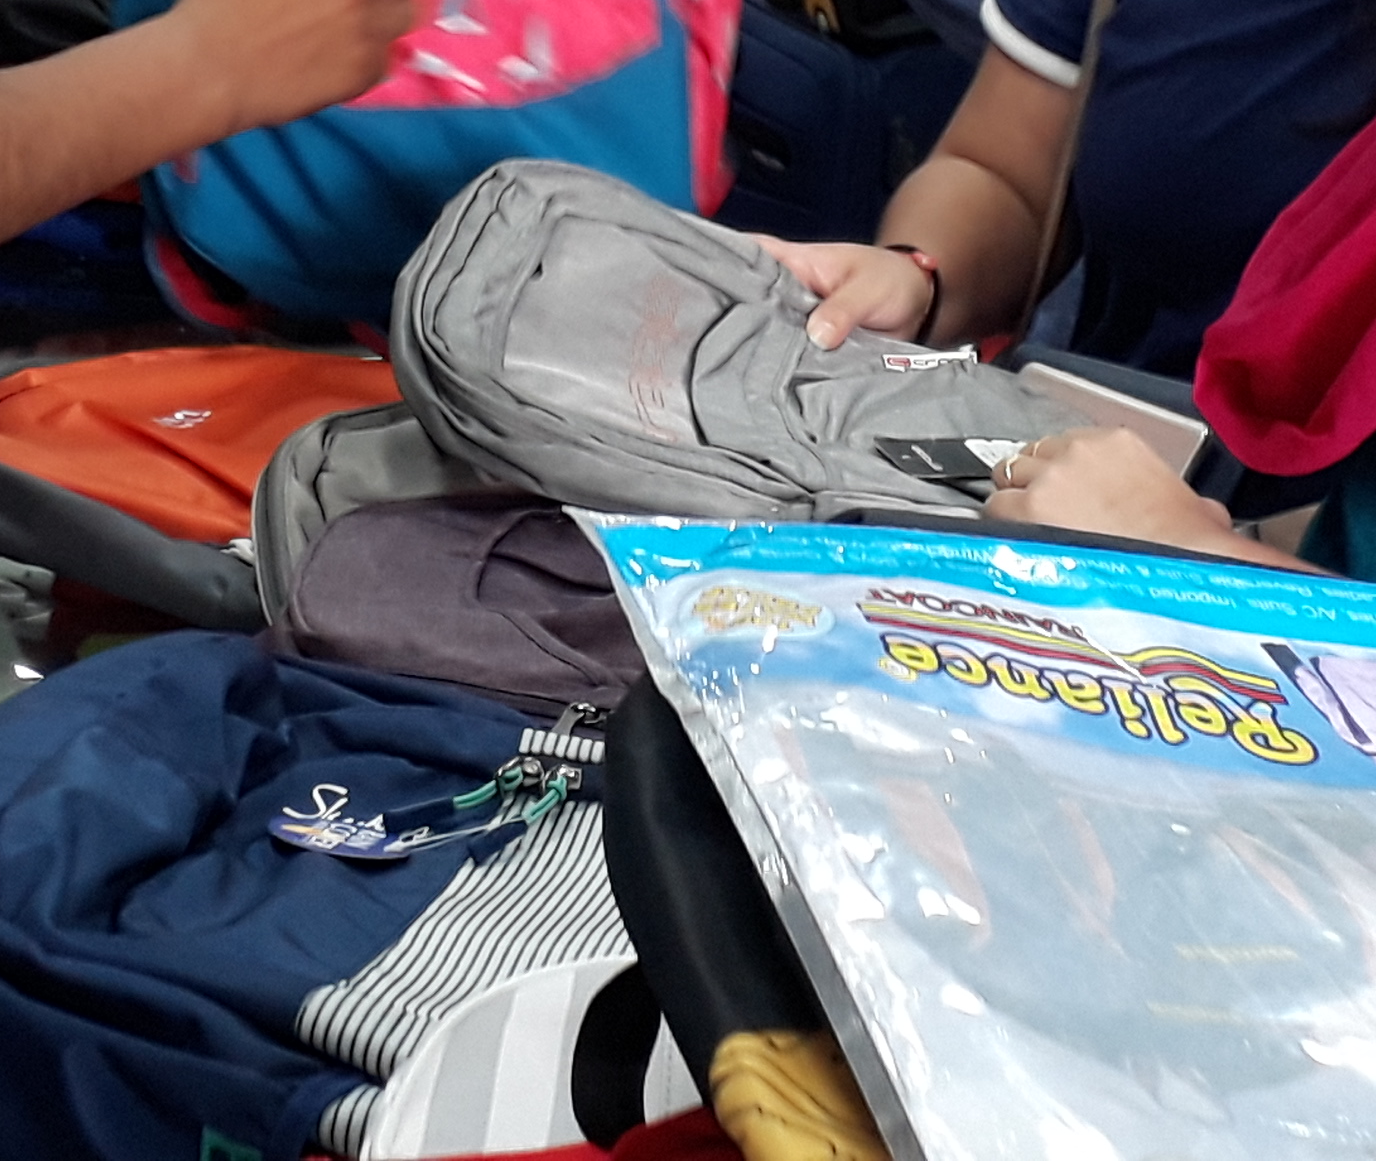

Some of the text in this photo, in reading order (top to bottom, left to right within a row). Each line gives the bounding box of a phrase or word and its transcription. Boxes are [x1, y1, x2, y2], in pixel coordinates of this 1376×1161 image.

[868, 587, 1084, 638] RAINCOAT
[1149, 586, 1238, 610] Imported
[1300, 604, 1337, 622] A/C
[880, 631, 1321, 765] Reliance
